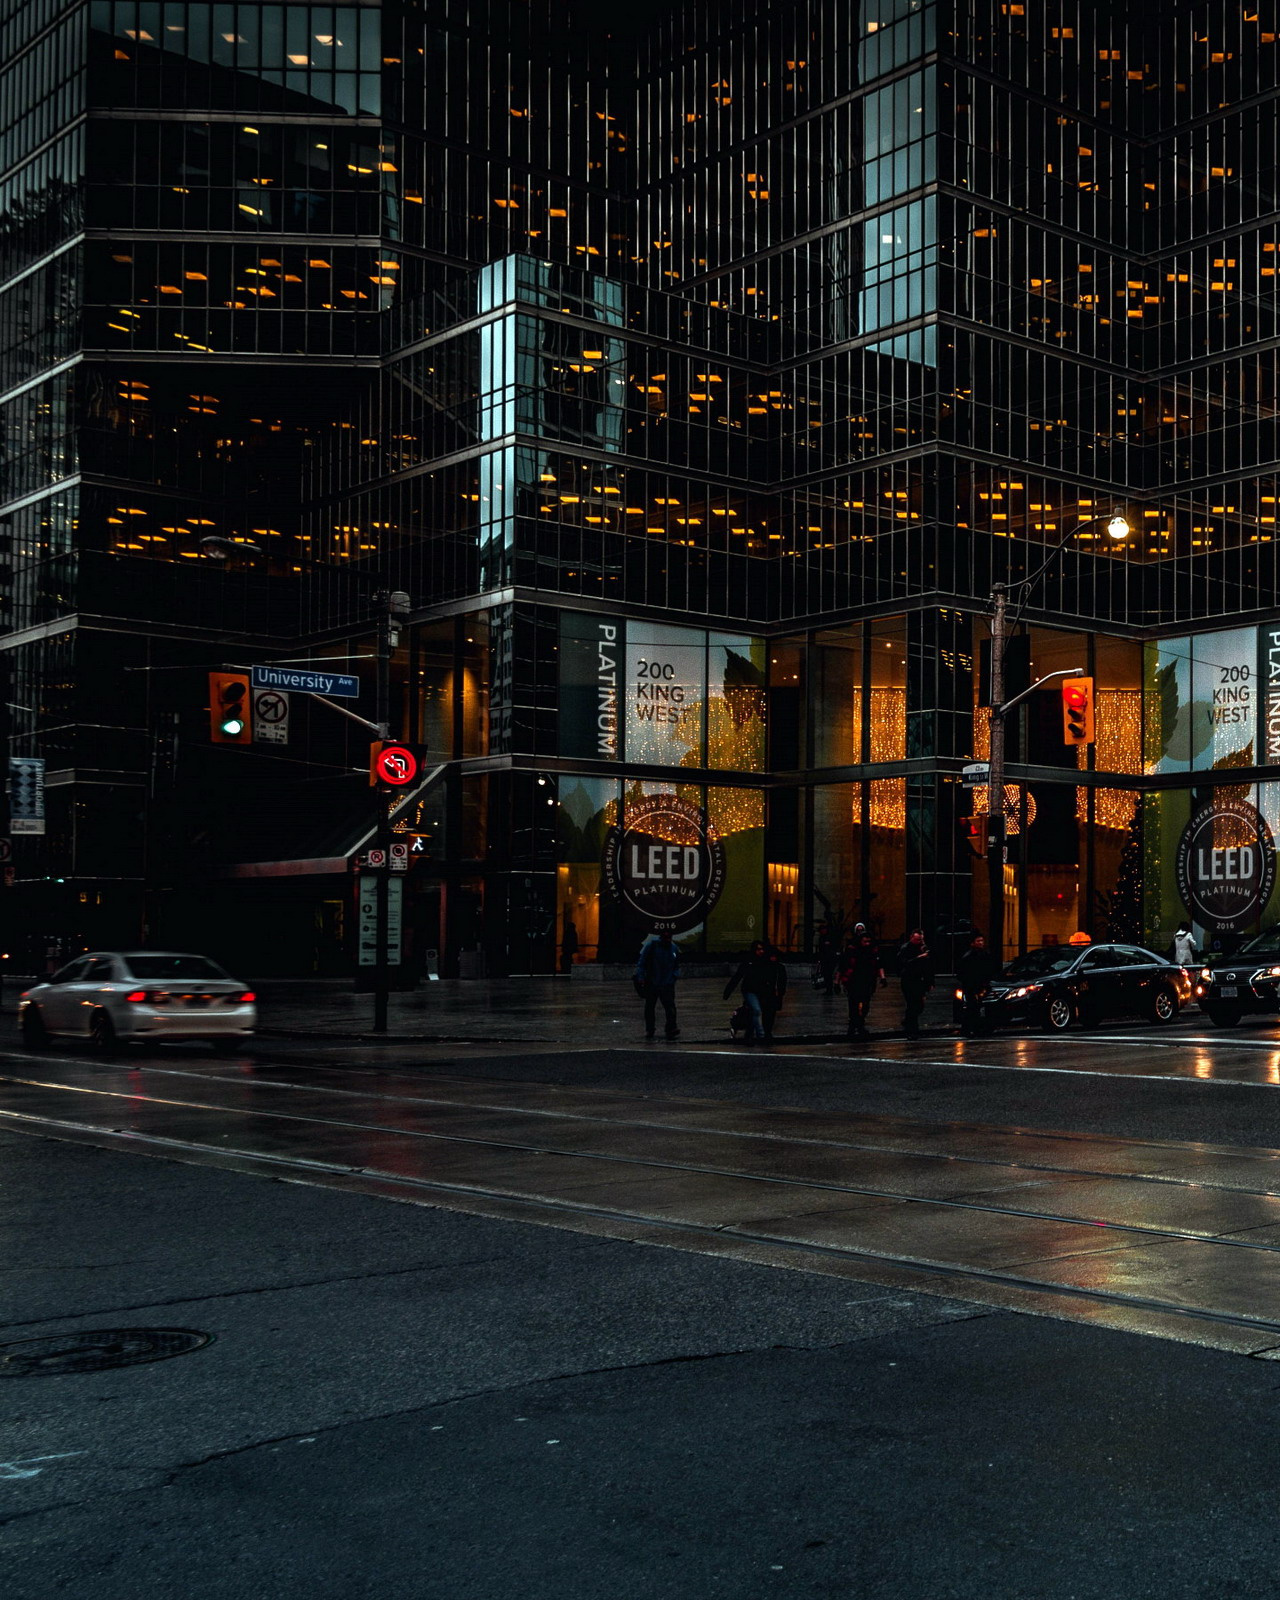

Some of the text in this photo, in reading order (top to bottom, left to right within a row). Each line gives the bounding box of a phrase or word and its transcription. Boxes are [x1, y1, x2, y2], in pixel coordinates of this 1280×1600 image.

[258, 669, 353, 693] University Ave
[636, 660, 675, 681] 200
[1220, 664, 1250, 684] 200
[597, 624, 616, 754] PLATINUM
[636, 682, 685, 703] KING
[1213, 685, 1250, 705] KING
[636, 703, 691, 725] WEST
[1207, 706, 1250, 725] WEST
[35, 764, 44, 817] OPPORTUNITY
[631, 844, 700, 880] LEED
[1198, 846, 1254, 881] LEED
[634, 884, 696, 898] PLATINUM
[706, 870, 722, 906] DESIGN
[1200, 885, 1251, 899] PLATINUM
[1259, 867, 1273, 905] DESIGN
[654, 922, 677, 930] 2016
[1216, 922, 1235, 930] 2016
